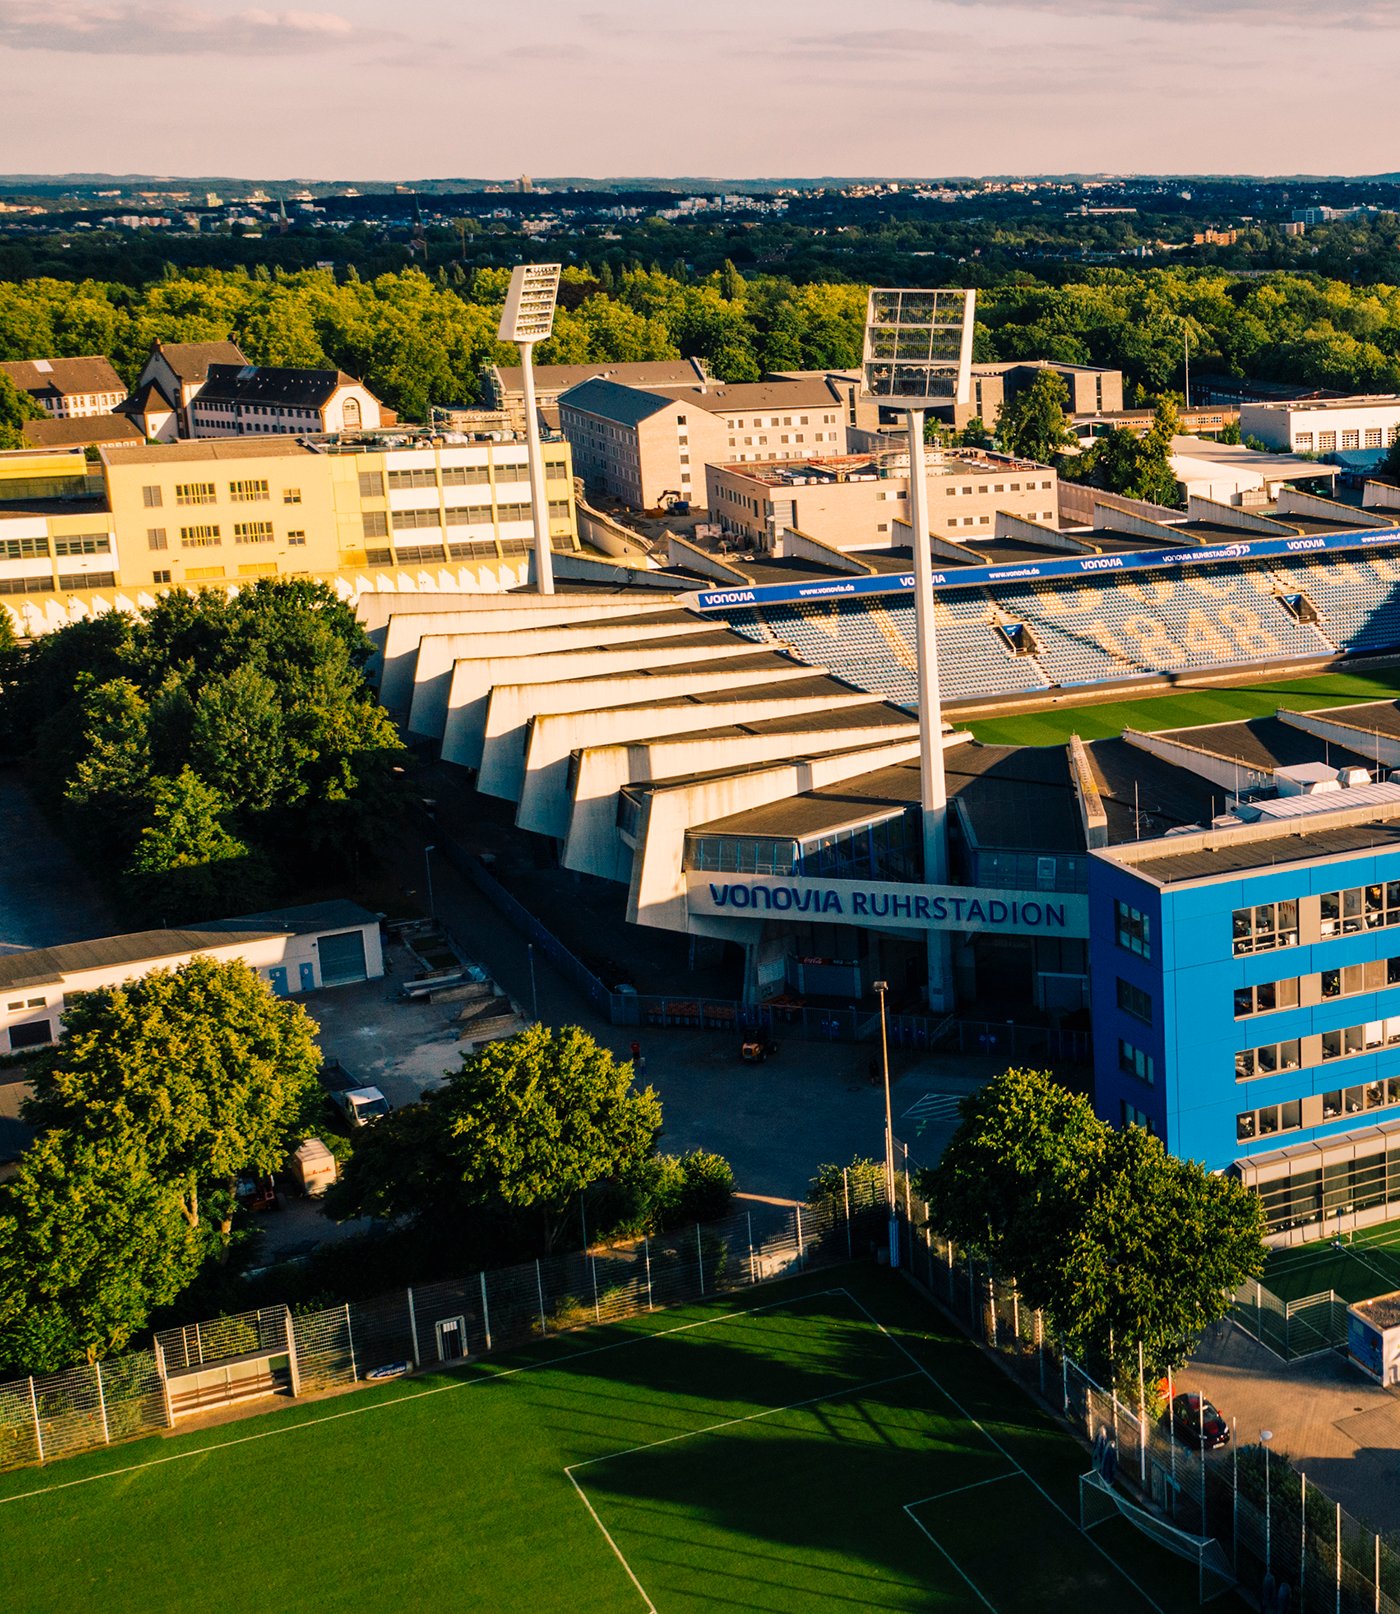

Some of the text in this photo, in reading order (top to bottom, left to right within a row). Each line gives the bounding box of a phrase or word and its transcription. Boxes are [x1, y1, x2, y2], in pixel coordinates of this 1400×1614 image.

[1287, 539, 1325, 550] VONOVIA
[1080, 557, 1123, 570] VONOVIA
[988, 567, 1040, 579] www.vonovia.de
[900, 574, 946, 587] VOVIA
[799, 584, 855, 596] www.vonovia.de
[704, 591, 755, 605] VONOVIA
[709, 882, 1066, 928] VONOVIA RUHRSTADION
